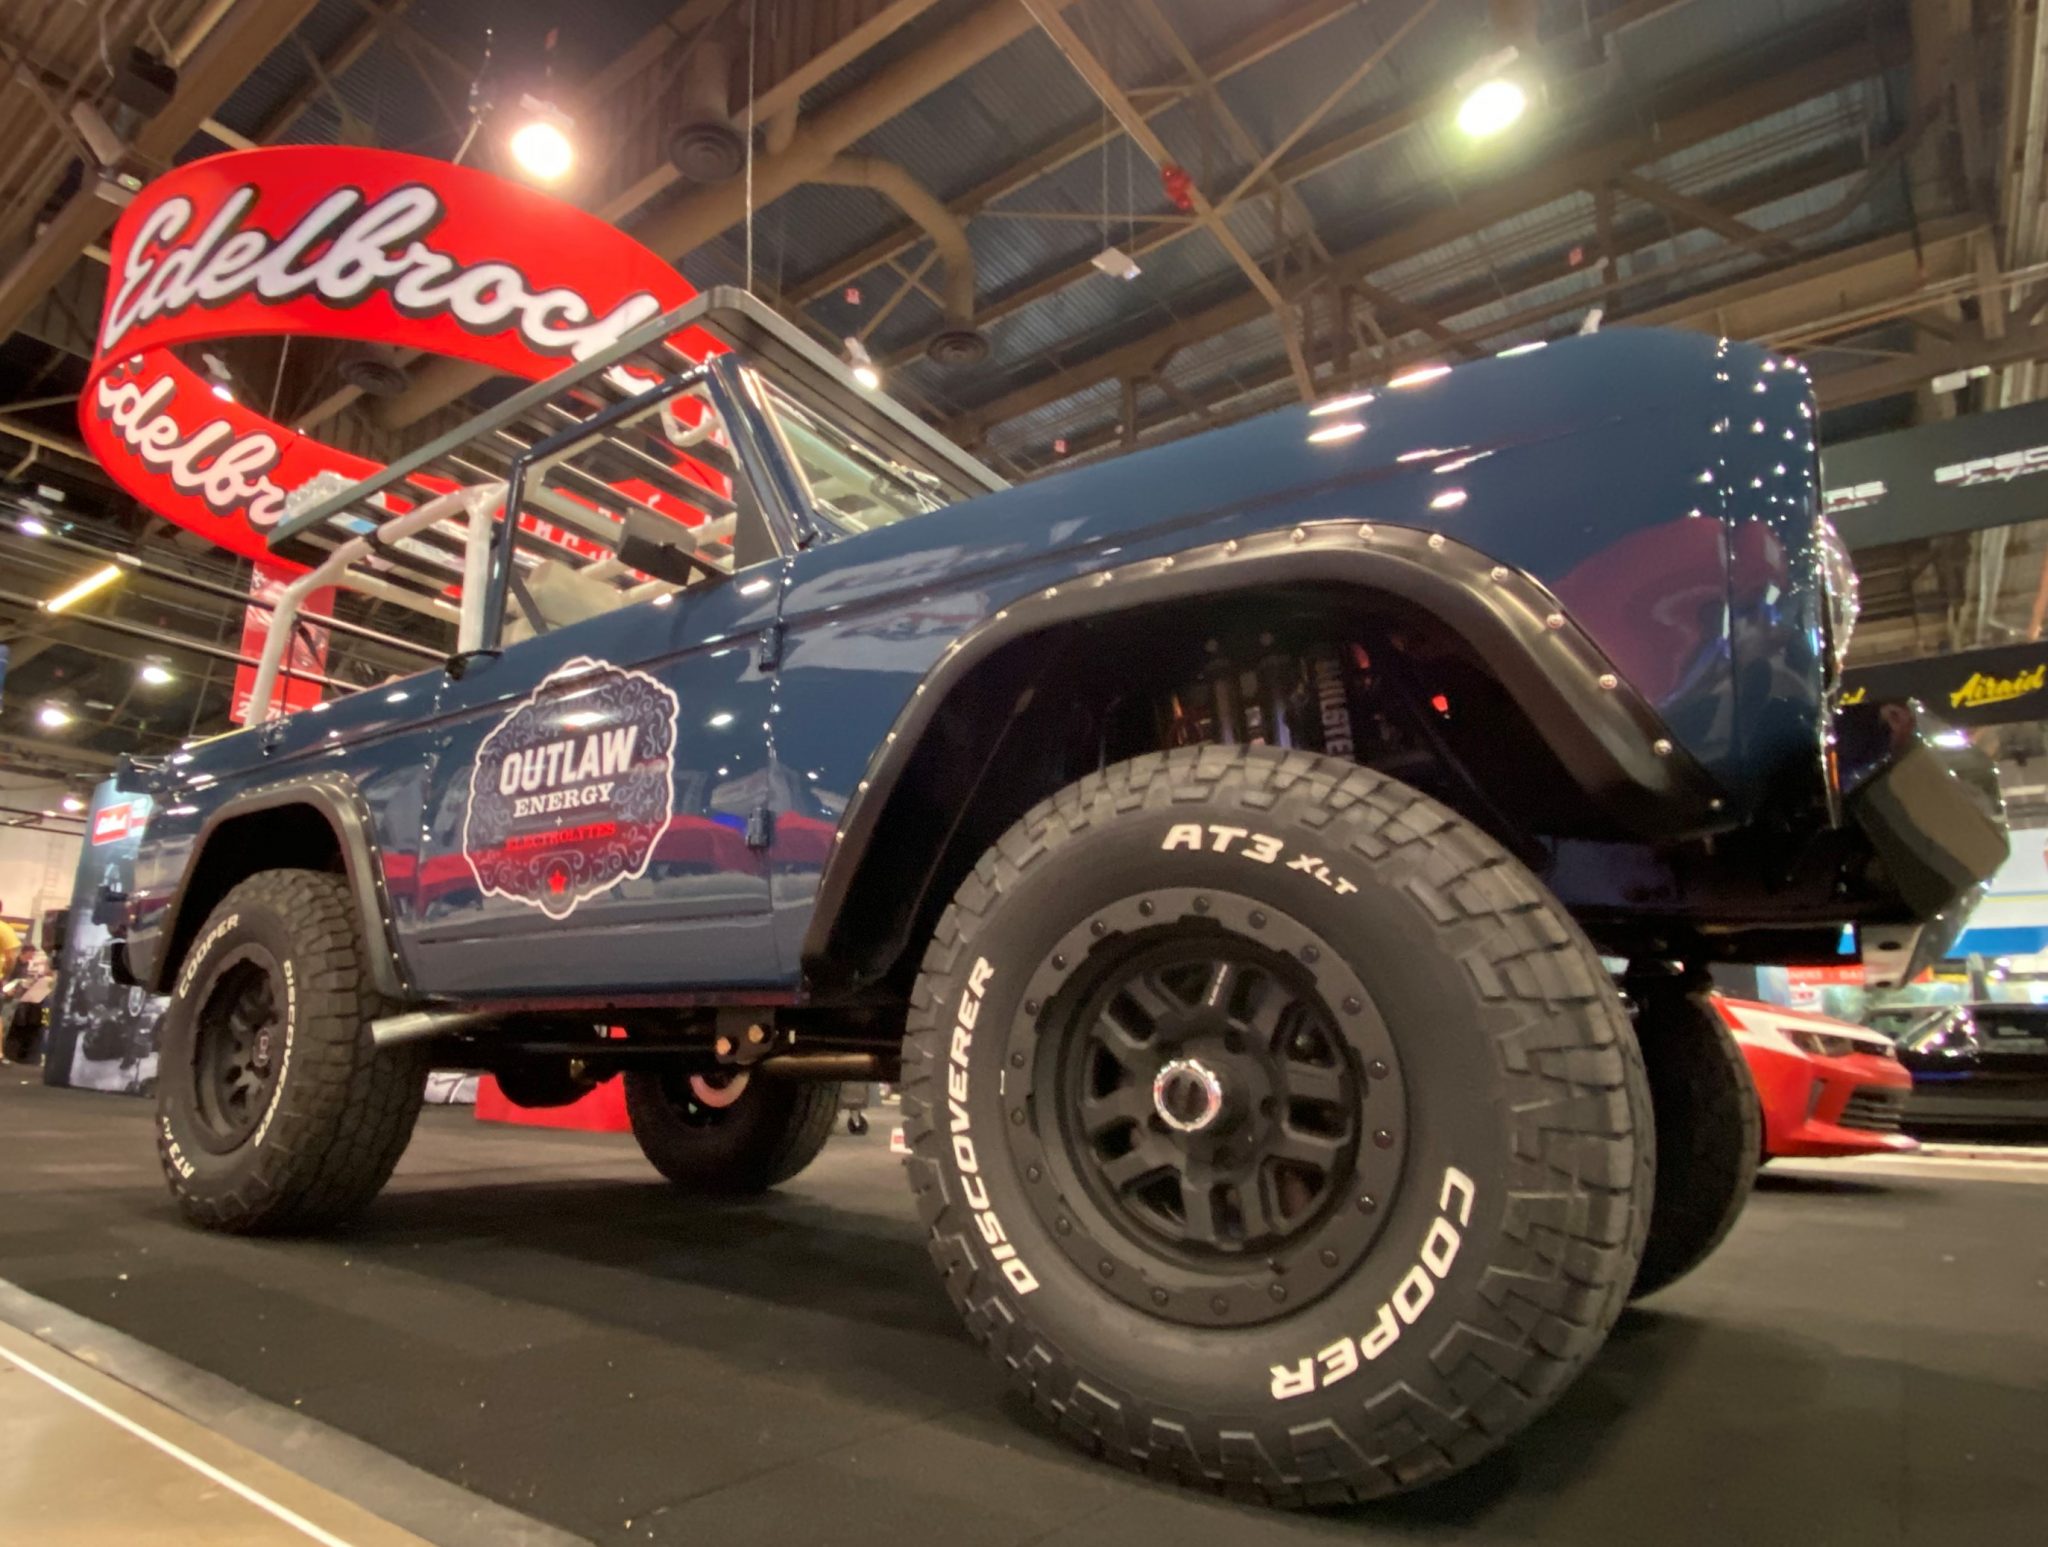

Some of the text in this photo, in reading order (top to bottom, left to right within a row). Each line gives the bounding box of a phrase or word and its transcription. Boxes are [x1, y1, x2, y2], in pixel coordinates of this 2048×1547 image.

[500, 724, 638, 796] OUTLAW
[513, 782, 615, 818] ENERGY
[1161, 823, 1359, 895] AT3 XLT
[179, 913, 239, 1000] COOPER
[254, 960, 296, 1147] DISCOVERER
[168, 1142, 195, 1179] AT3
[948, 956, 1039, 1294] DISCOVERER
[1270, 1166, 1476, 1400] COOPER
